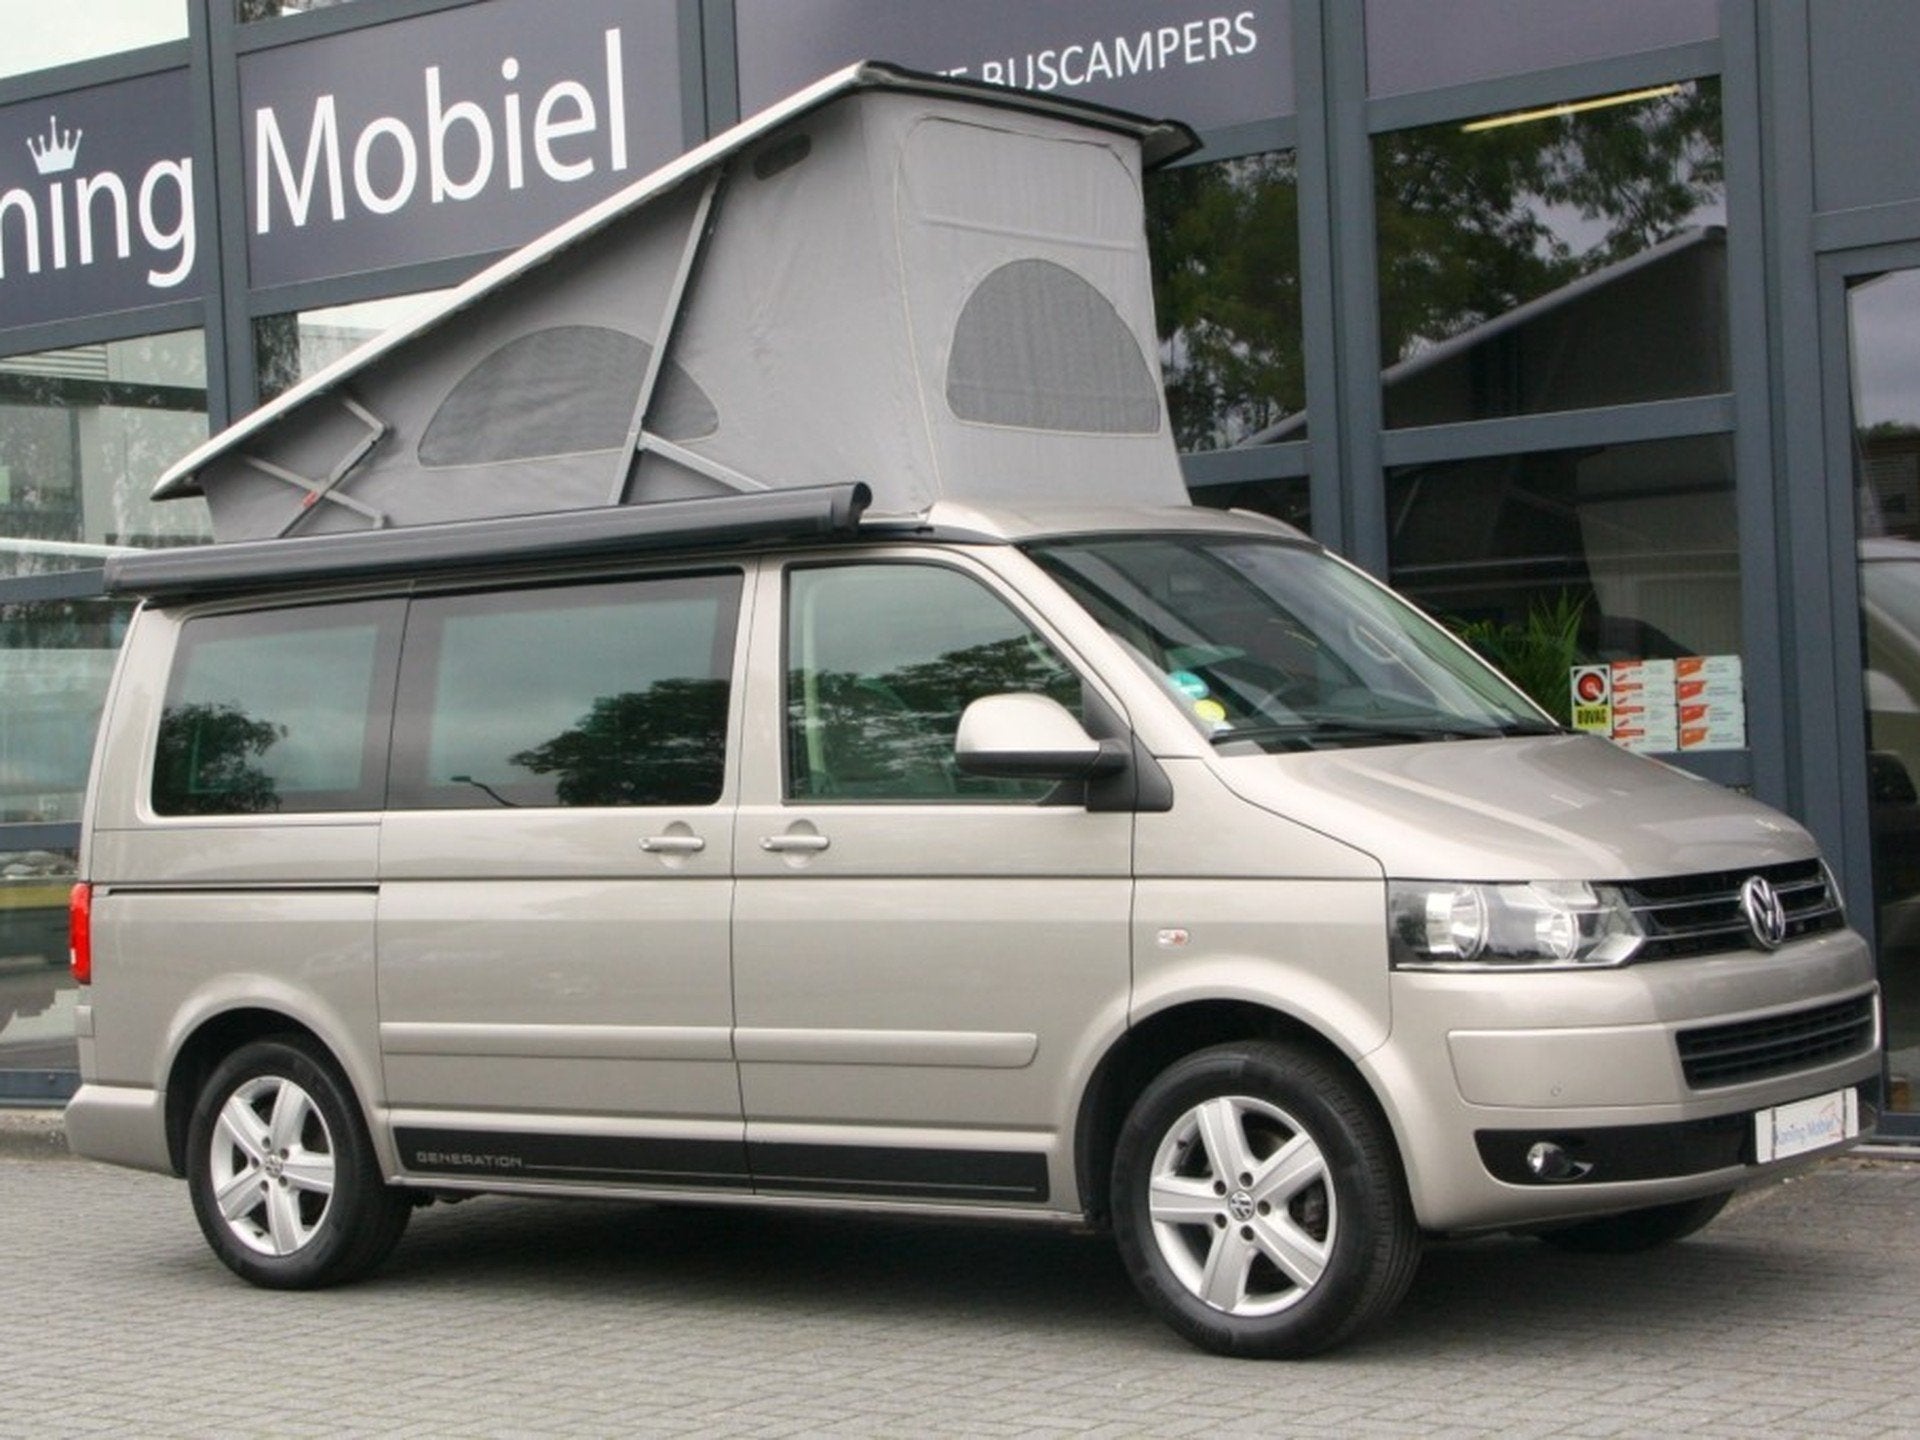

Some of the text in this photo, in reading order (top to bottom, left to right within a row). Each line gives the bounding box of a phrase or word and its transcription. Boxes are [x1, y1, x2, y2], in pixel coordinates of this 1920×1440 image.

[982, 11, 1258, 91] BUSCAMPERS
[0, 28, 628, 288] ning Mobiel
[415, 1151, 523, 1168] GENERATION
